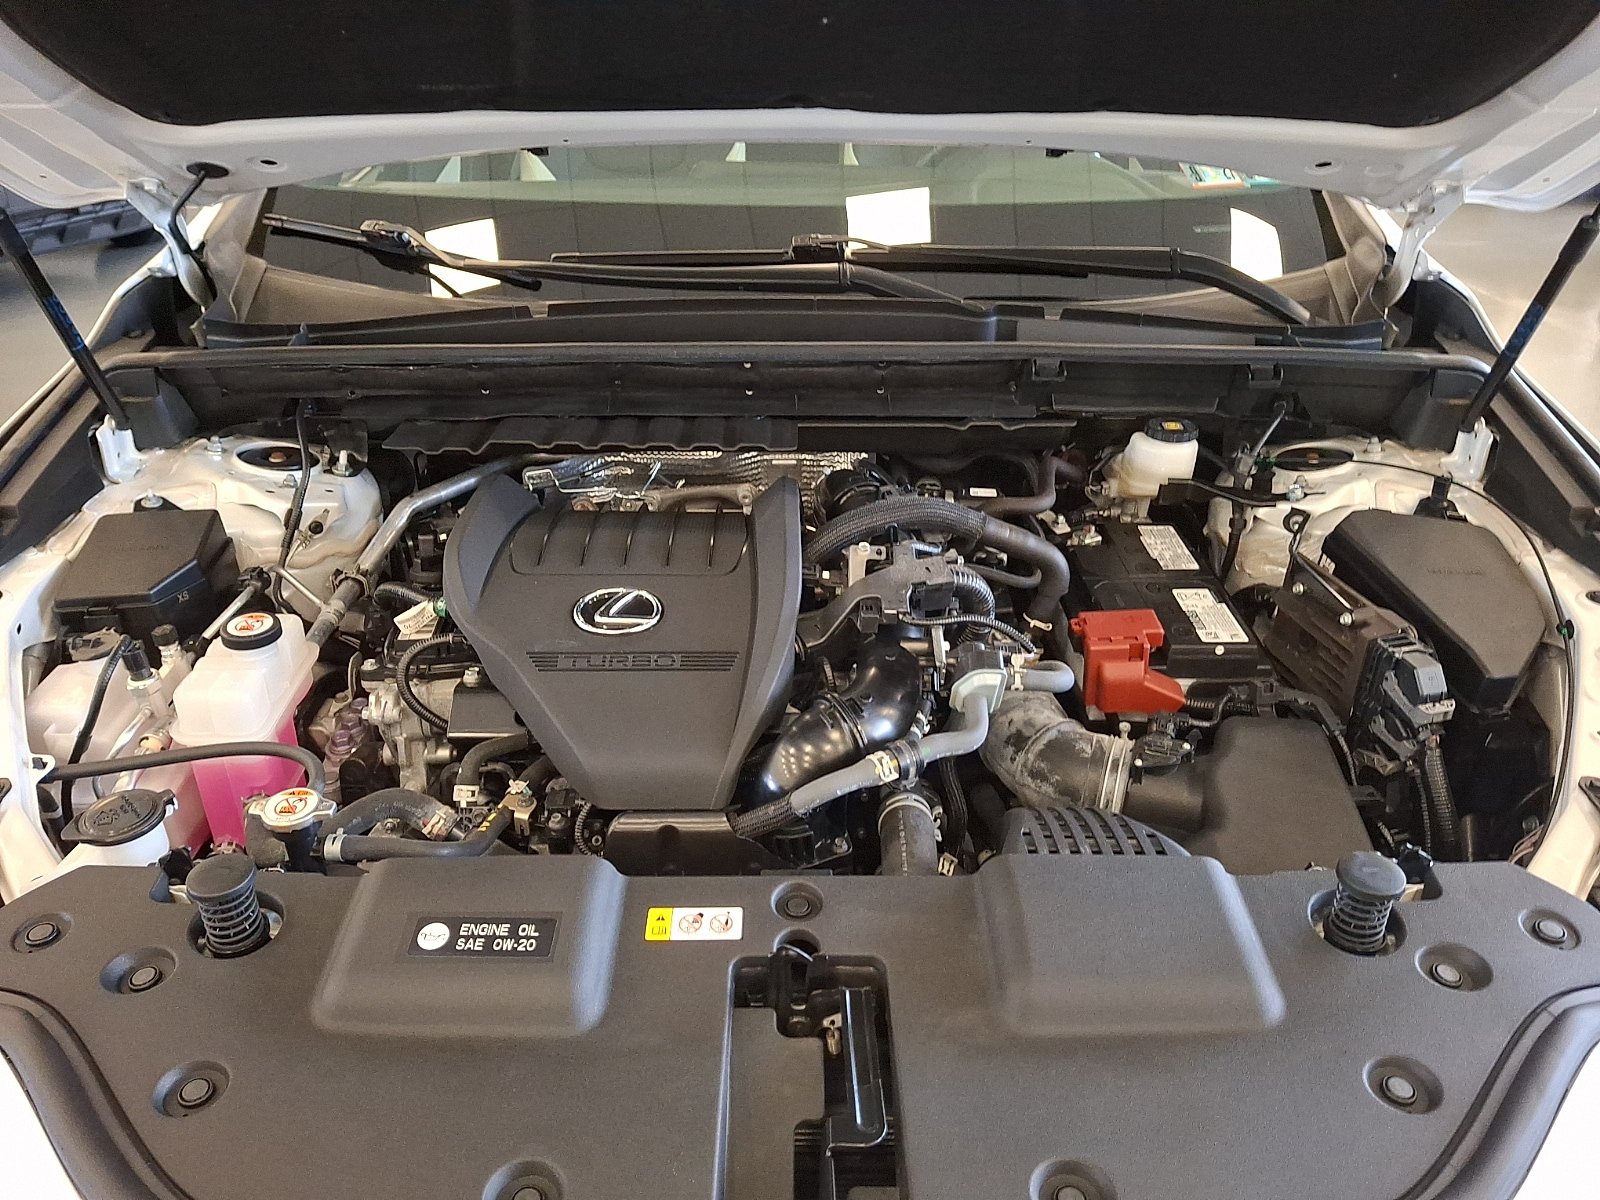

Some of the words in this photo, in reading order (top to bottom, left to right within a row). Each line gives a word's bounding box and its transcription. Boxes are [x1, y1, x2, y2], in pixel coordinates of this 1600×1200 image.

[561, 654, 681, 669] TURBO
[459, 923, 511, 937] ENGINE
[517, 924, 540, 937] OIL
[455, 938, 485, 951] SAE
[492, 938, 536, 951] 0W-20
